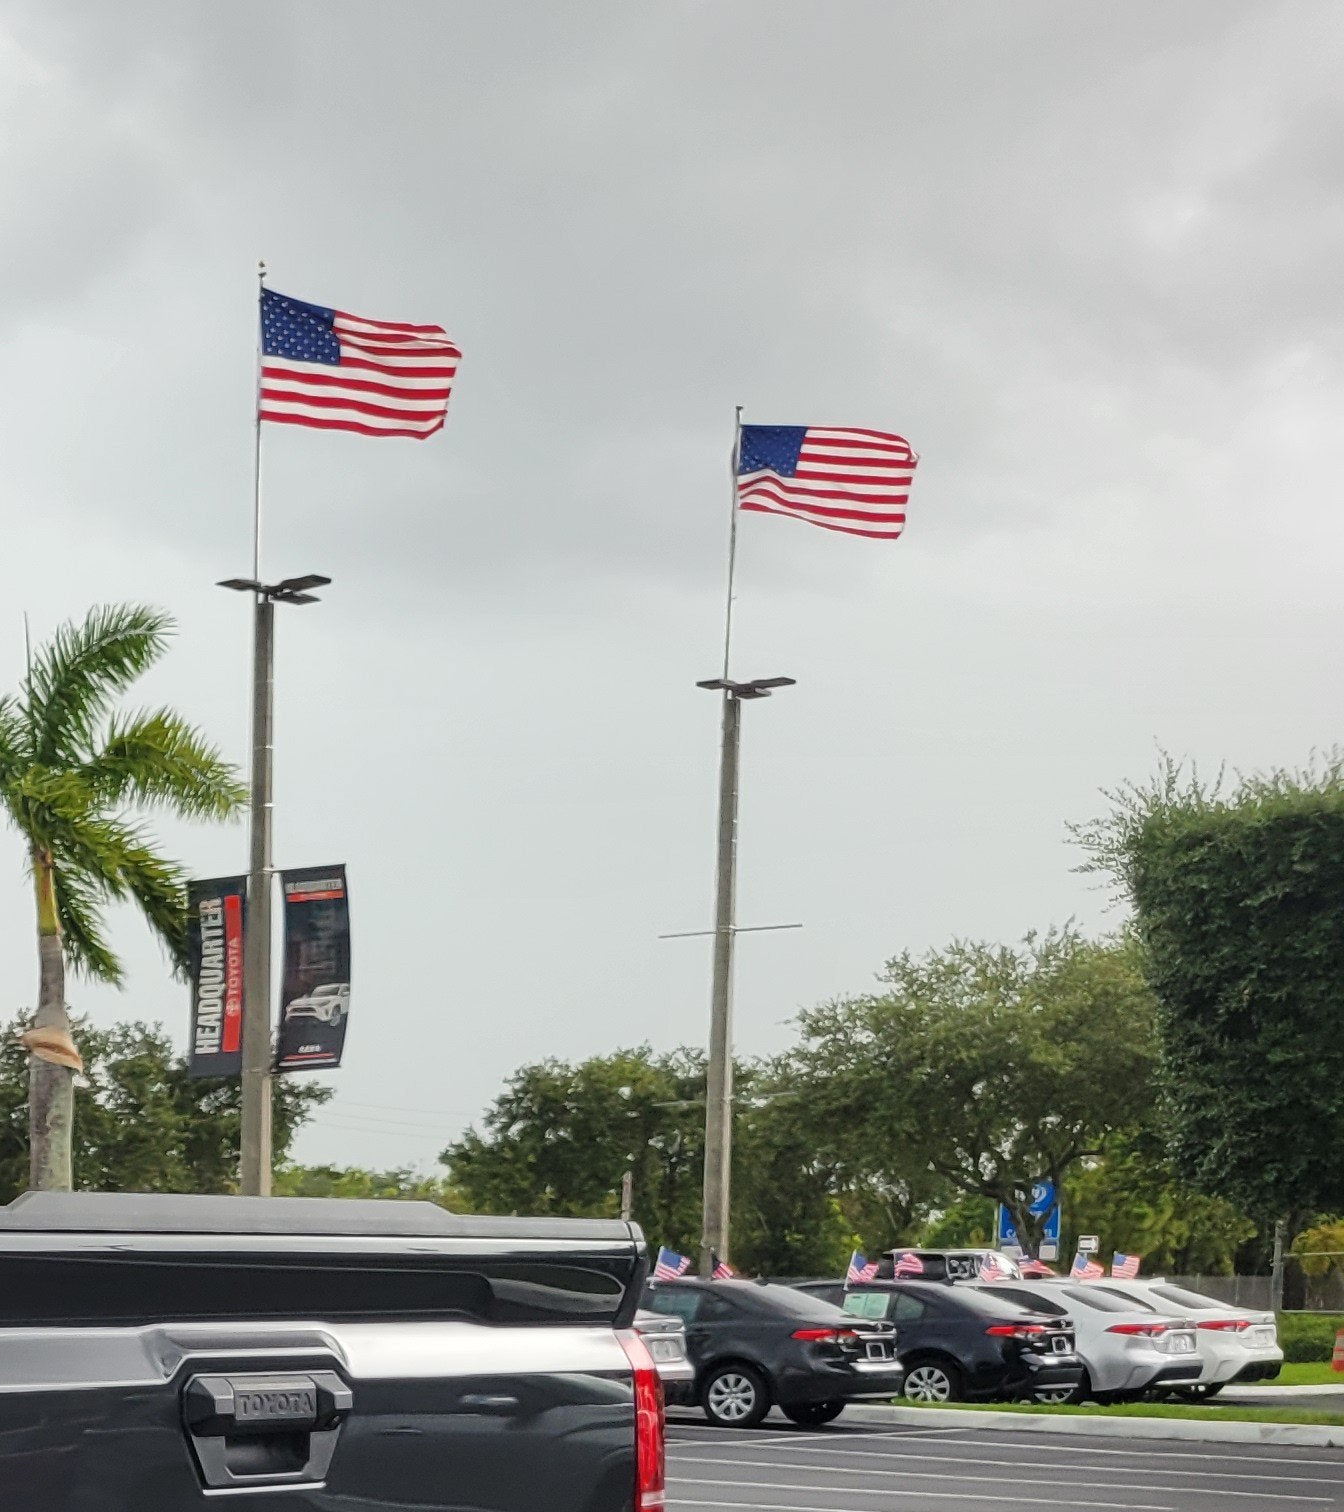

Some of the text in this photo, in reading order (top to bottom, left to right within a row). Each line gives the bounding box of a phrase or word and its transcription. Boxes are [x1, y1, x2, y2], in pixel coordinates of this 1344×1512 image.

[195, 897, 225, 1055] HEADQUARTER
[228, 937, 240, 996] TOYOTA
[238, 1391, 314, 1415] TOYOTA
